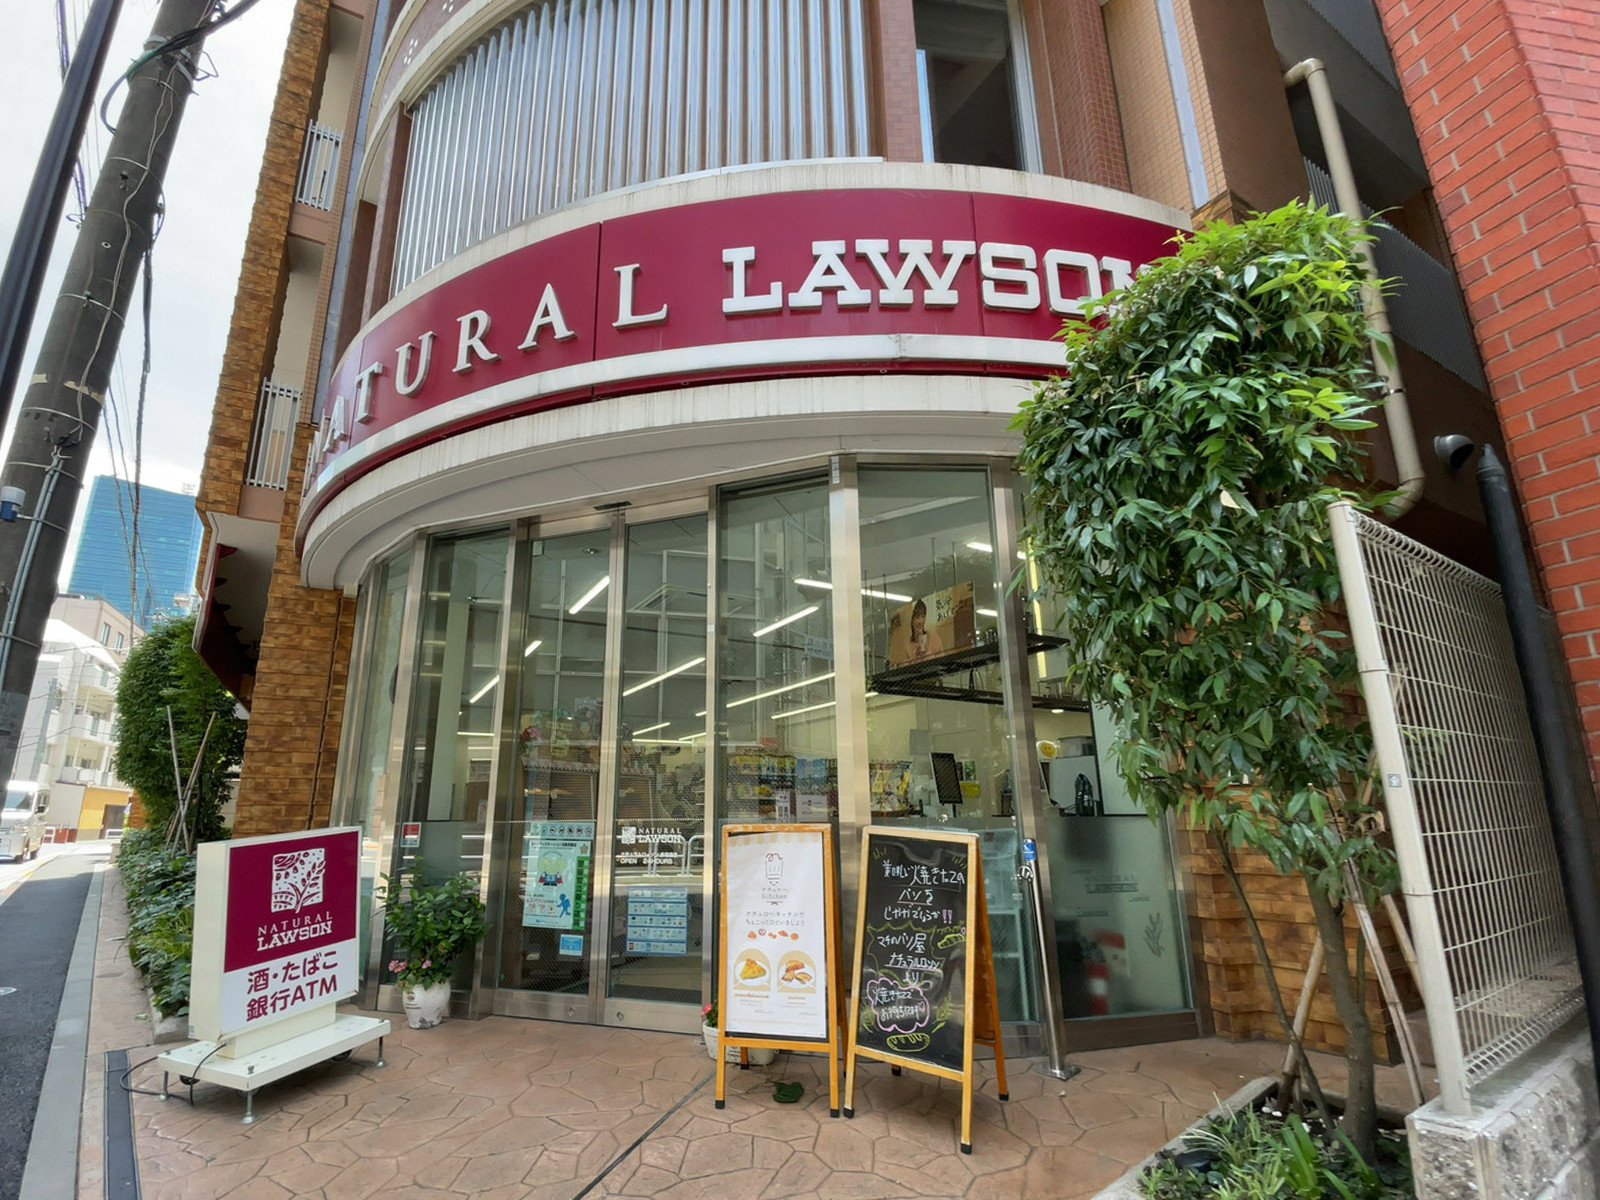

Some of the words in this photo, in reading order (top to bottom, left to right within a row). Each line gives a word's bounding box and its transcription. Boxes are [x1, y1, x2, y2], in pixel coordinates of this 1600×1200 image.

[898, 888, 934, 906] パンを
[257, 911, 333, 936] NATURAL
[257, 920, 333, 951] LAWSON
[246, 950, 339, 996] 酒・たばこ
[245, 973, 338, 1022] 銀行ATM
